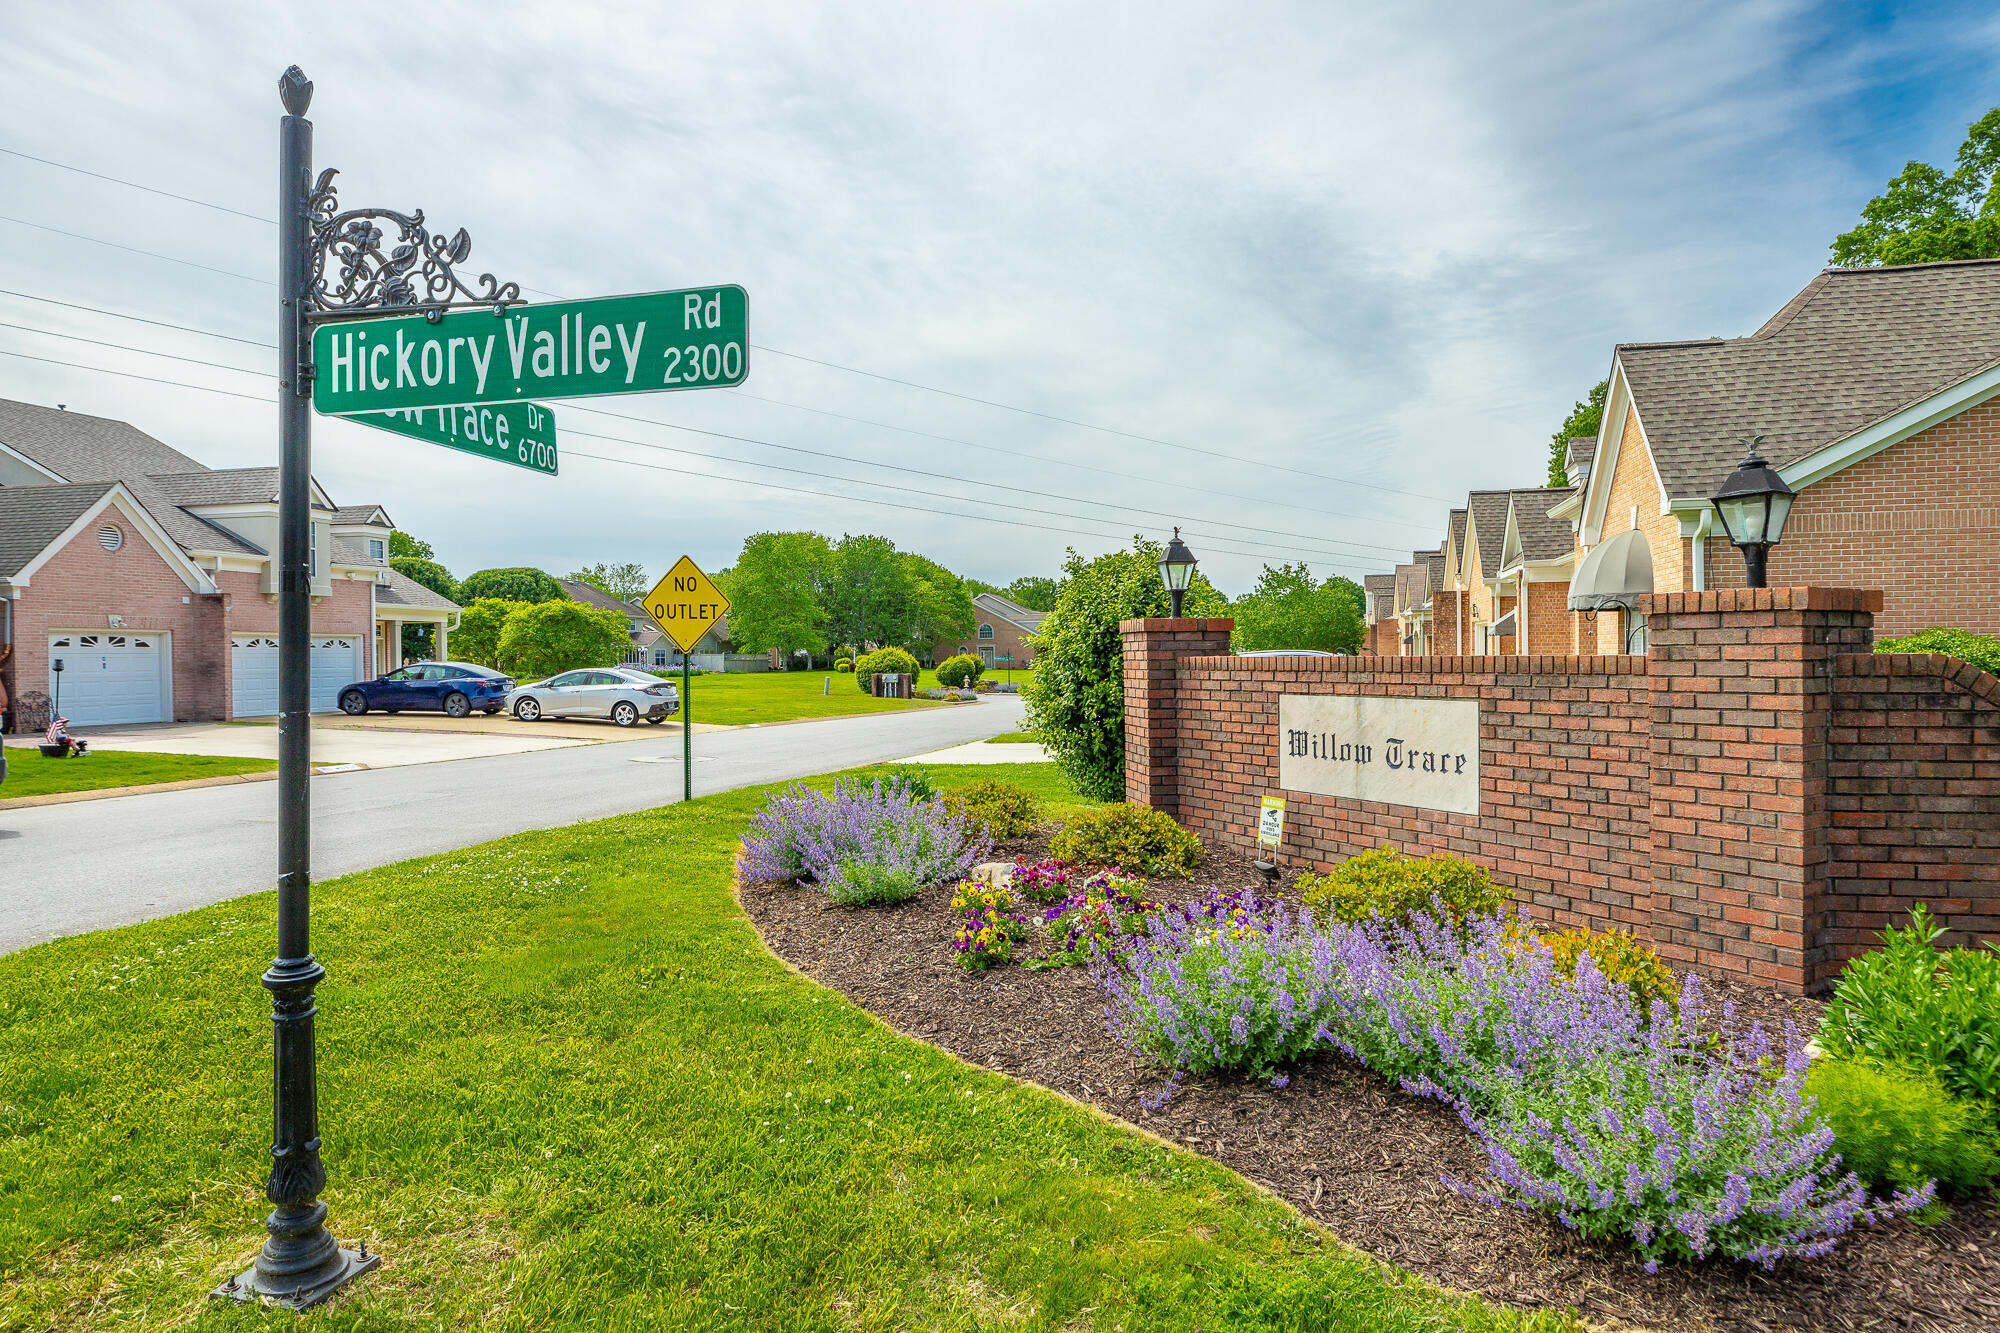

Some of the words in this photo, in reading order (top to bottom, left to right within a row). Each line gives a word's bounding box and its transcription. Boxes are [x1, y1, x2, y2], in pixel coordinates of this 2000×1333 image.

[684, 291, 721, 330] Rd
[331, 328, 495, 395] Hickory
[505, 311, 647, 384] Valley
[663, 341, 742, 384] 2300
[527, 403, 545, 432] Dr
[518, 438, 556, 470] 6700
[674, 576, 697, 592] NO
[654, 603, 718, 619] OUTLET
[1287, 728, 1373, 765] Willow
[1385, 737, 1467, 775] Trace
